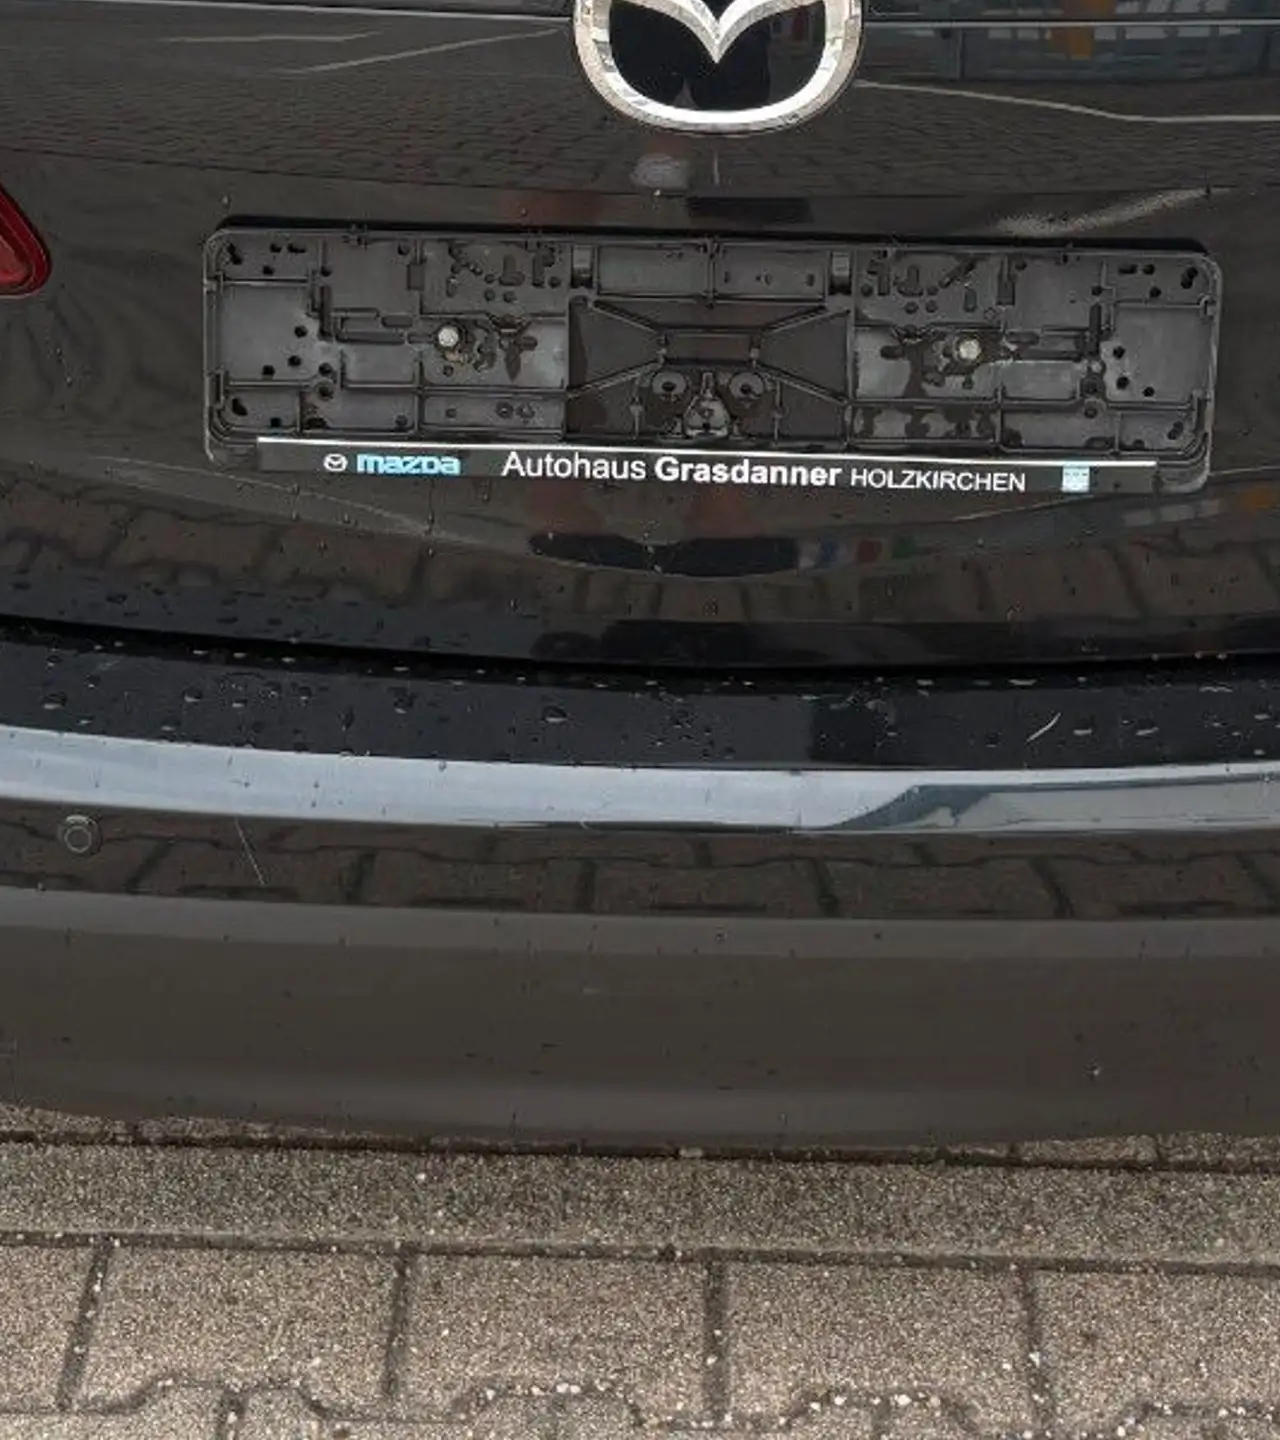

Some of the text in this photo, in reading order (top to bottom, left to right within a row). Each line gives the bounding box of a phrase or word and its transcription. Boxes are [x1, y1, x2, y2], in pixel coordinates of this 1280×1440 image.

[355, 450, 1027, 493] mazda Autohaus Grasdanner HOLZKIRCHEN
